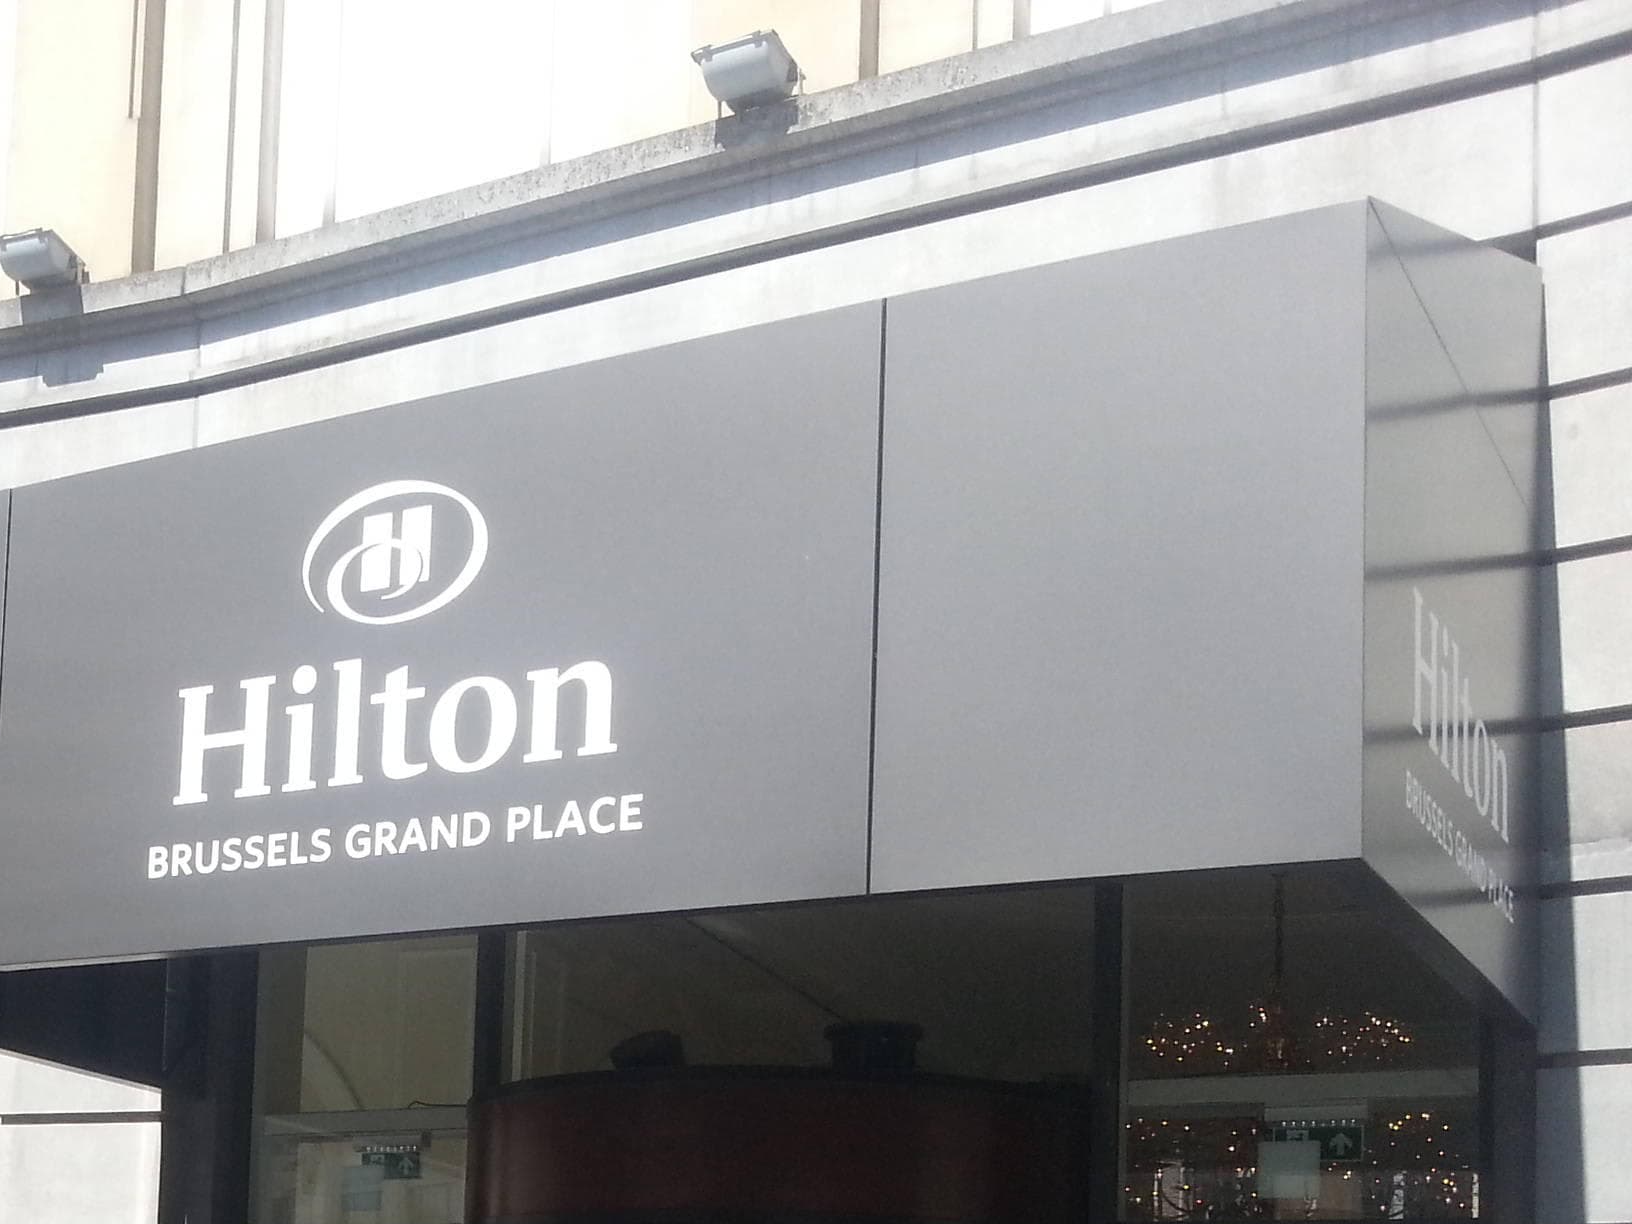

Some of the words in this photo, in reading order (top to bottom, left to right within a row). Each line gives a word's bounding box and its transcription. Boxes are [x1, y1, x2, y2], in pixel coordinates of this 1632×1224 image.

[172, 657, 619, 806] Hilton
[1412, 585, 1509, 844] Hilton
[147, 827, 332, 880] BRUSSELS
[344, 810, 491, 859] GRAND
[505, 793, 645, 843] PLACE
[1406, 769, 1454, 857] BRUSSELS
